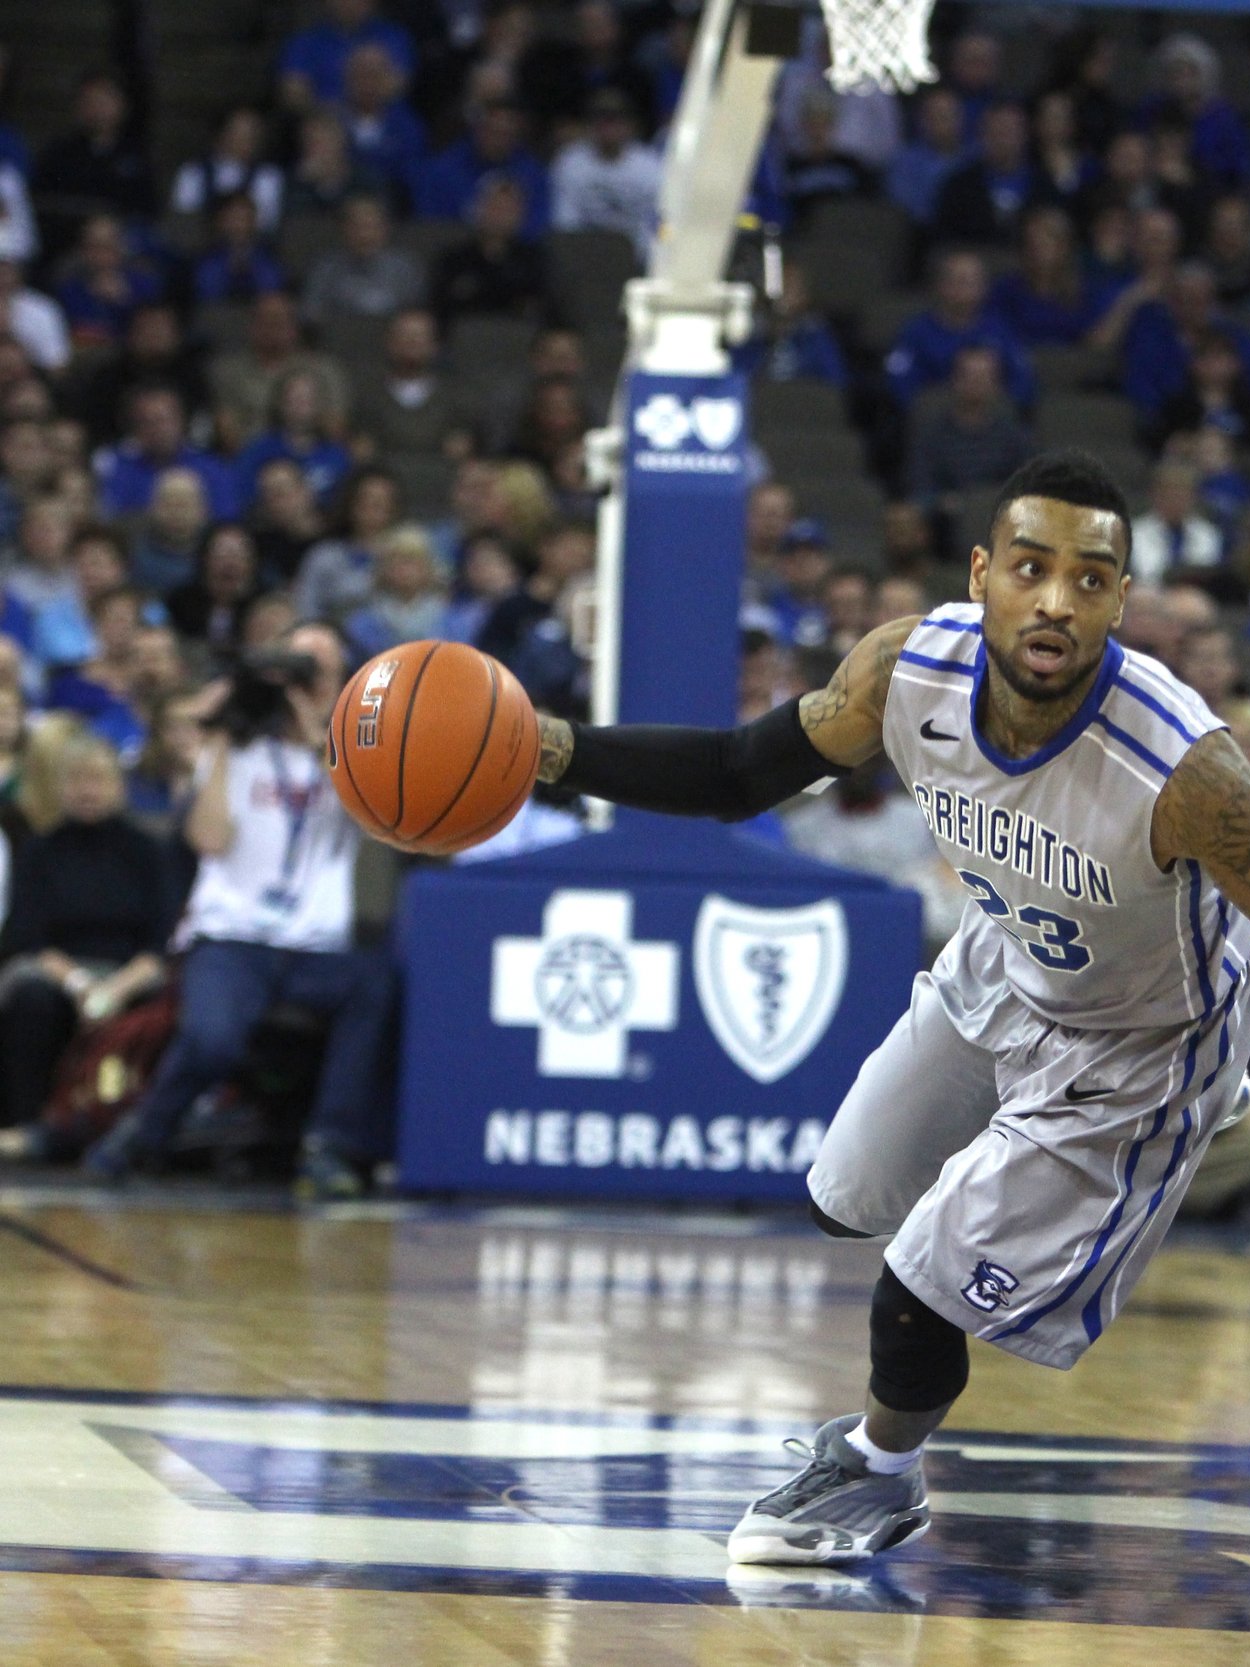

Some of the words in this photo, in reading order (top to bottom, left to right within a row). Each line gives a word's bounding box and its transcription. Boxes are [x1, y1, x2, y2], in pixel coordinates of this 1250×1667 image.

[912, 781, 1118, 907] CREIGHTON
[955, 867, 1095, 975] 23
[484, 1107, 828, 1174] NEBRASKA
